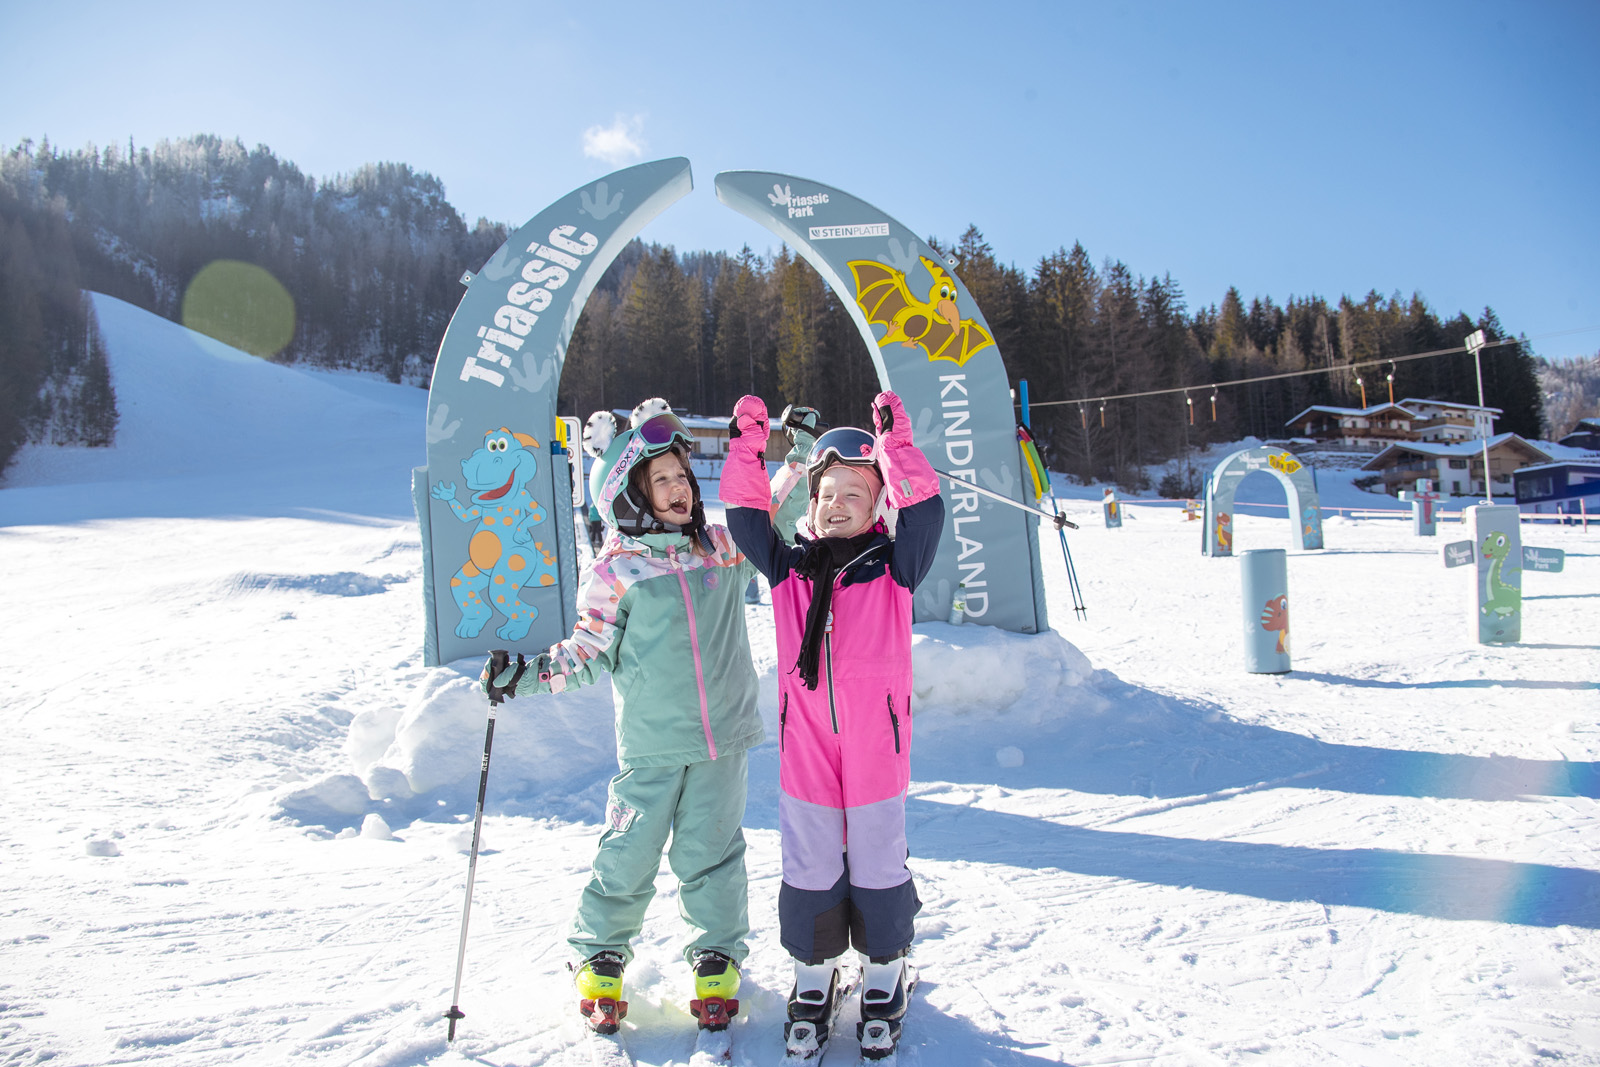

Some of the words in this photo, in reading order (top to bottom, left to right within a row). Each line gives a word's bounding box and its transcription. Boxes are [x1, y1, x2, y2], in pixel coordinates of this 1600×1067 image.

[788, 193, 830, 207] Triassic
[788, 205, 815, 219] Park
[822, 225, 888, 237] STEINPLATTE
[459, 225, 599, 388] Triassic
[615, 446, 635, 475] ROXY
[939, 374, 989, 618] KINDERLAND
